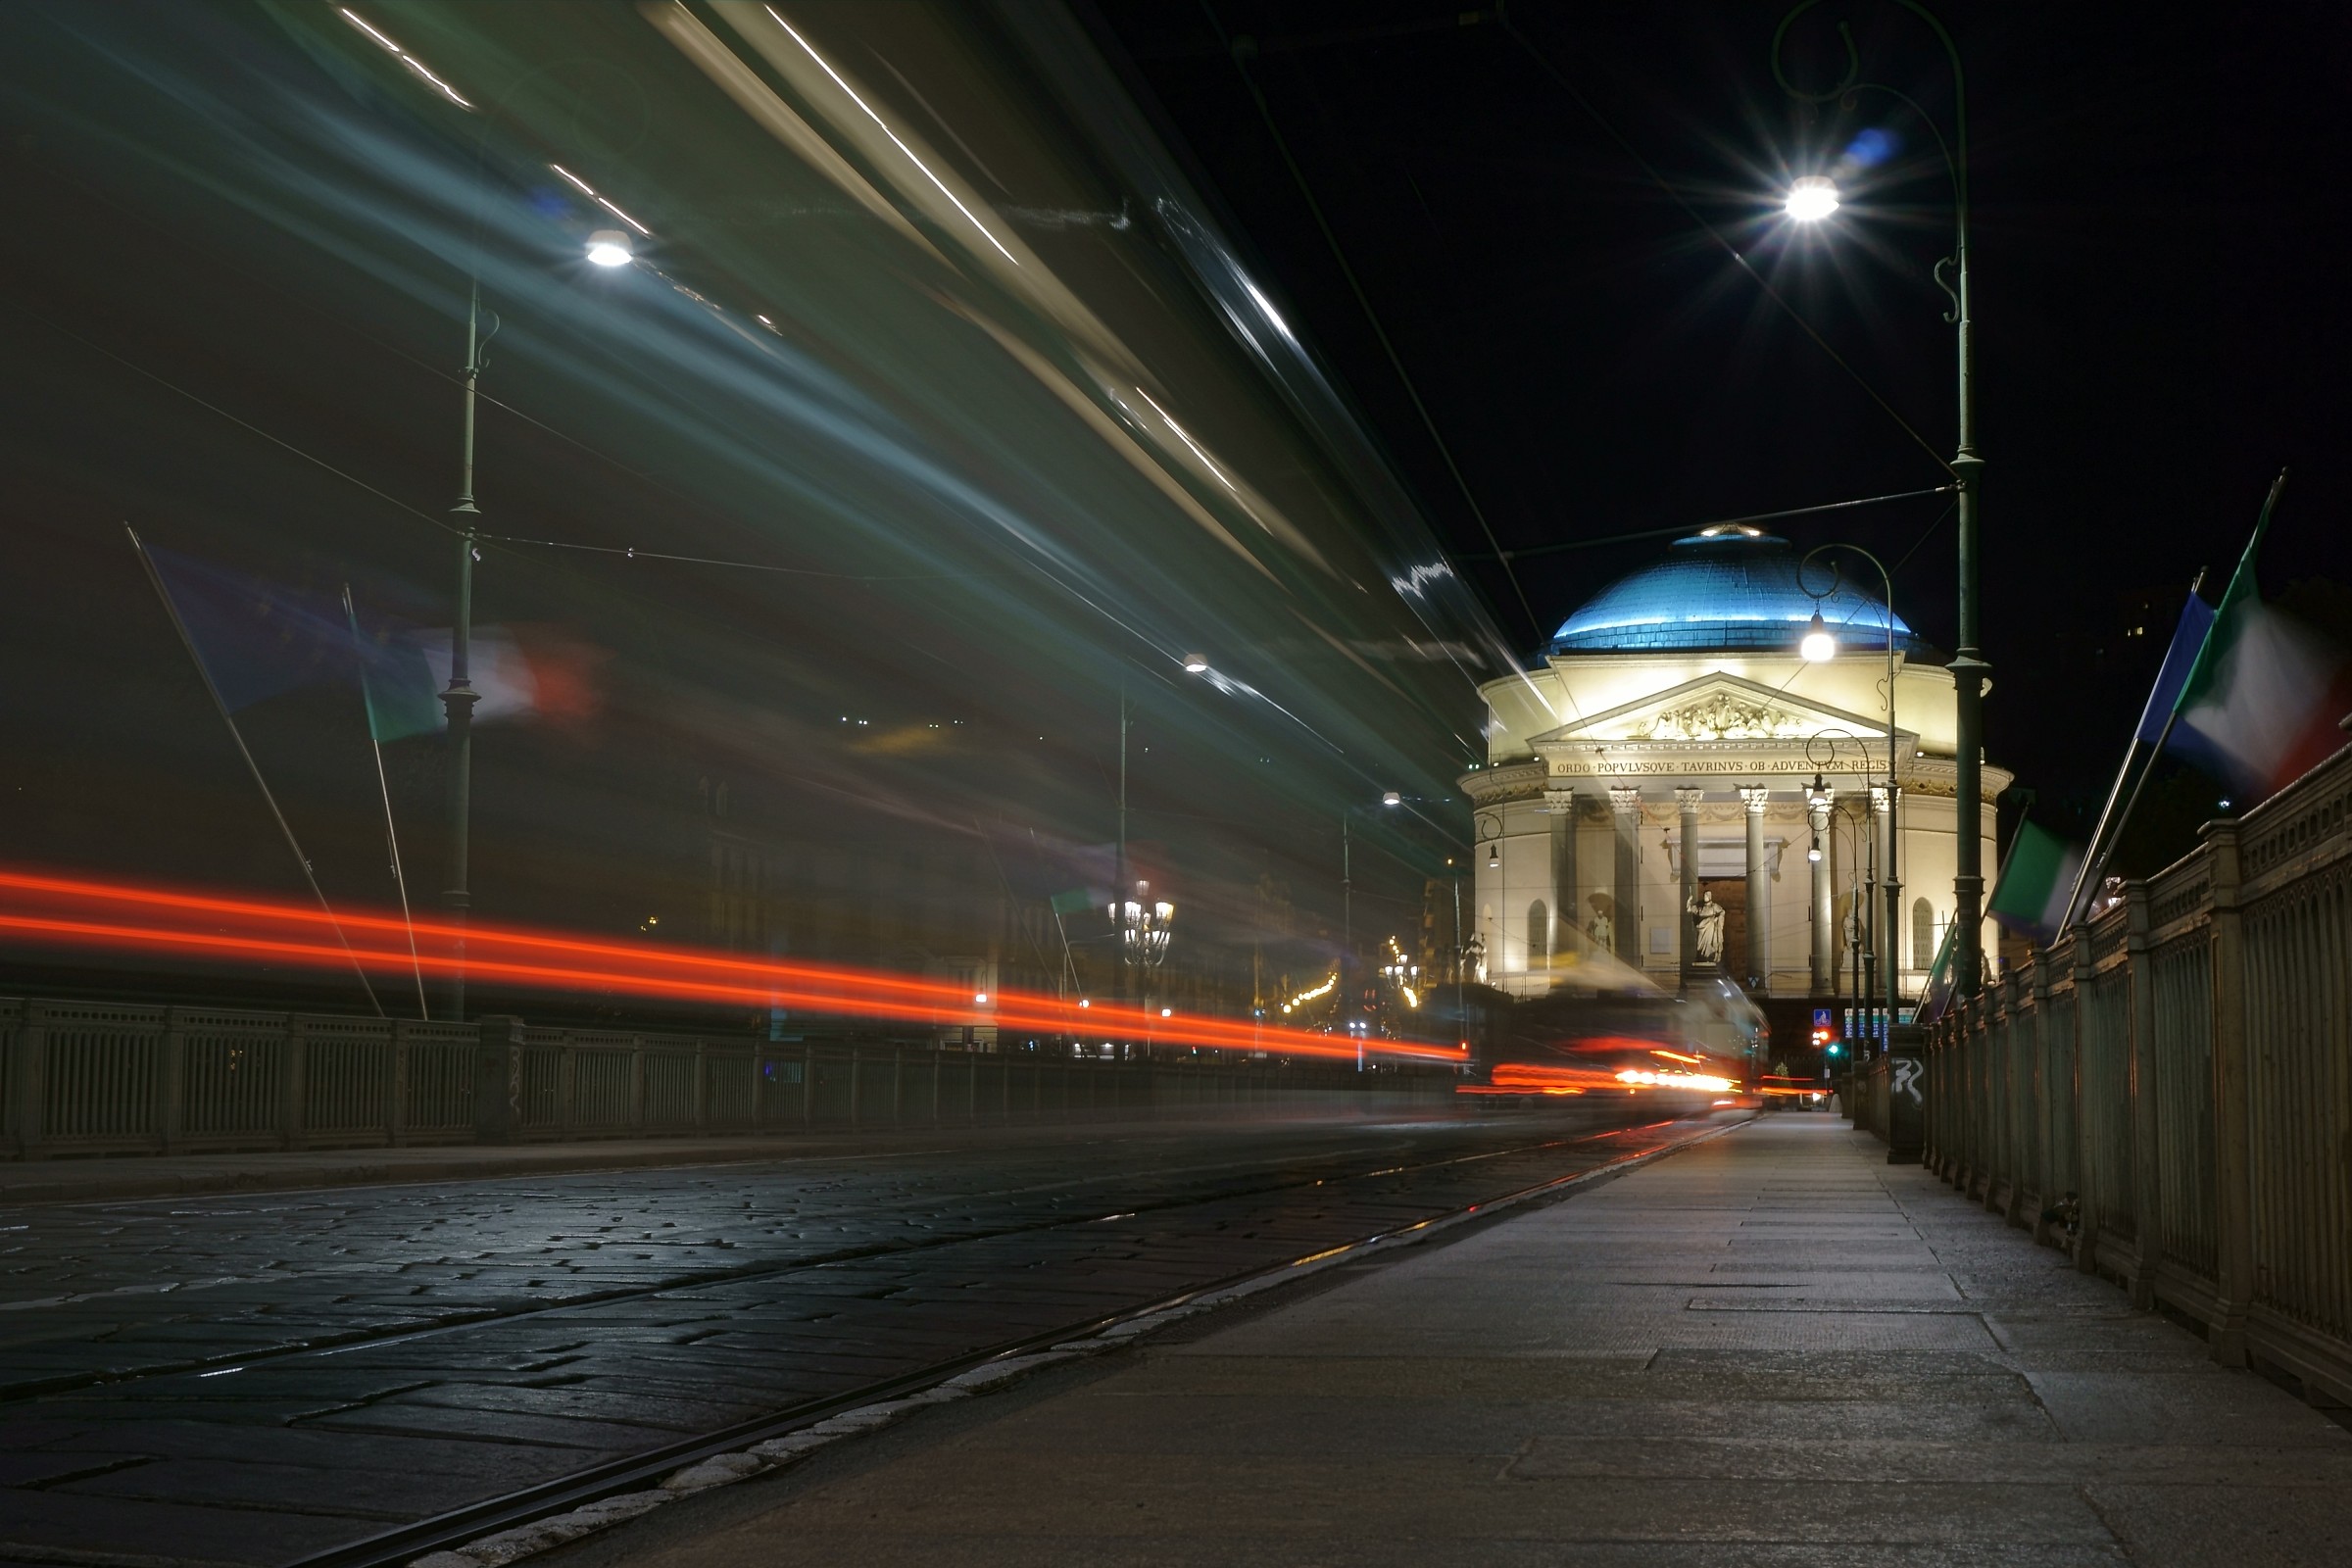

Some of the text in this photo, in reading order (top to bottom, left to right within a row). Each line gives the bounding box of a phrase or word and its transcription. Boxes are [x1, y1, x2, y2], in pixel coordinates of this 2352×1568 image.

[1557, 760, 1886, 773] ORDO POPVLVSQVE TAVRINVS OB ADVENTVM REGIS
